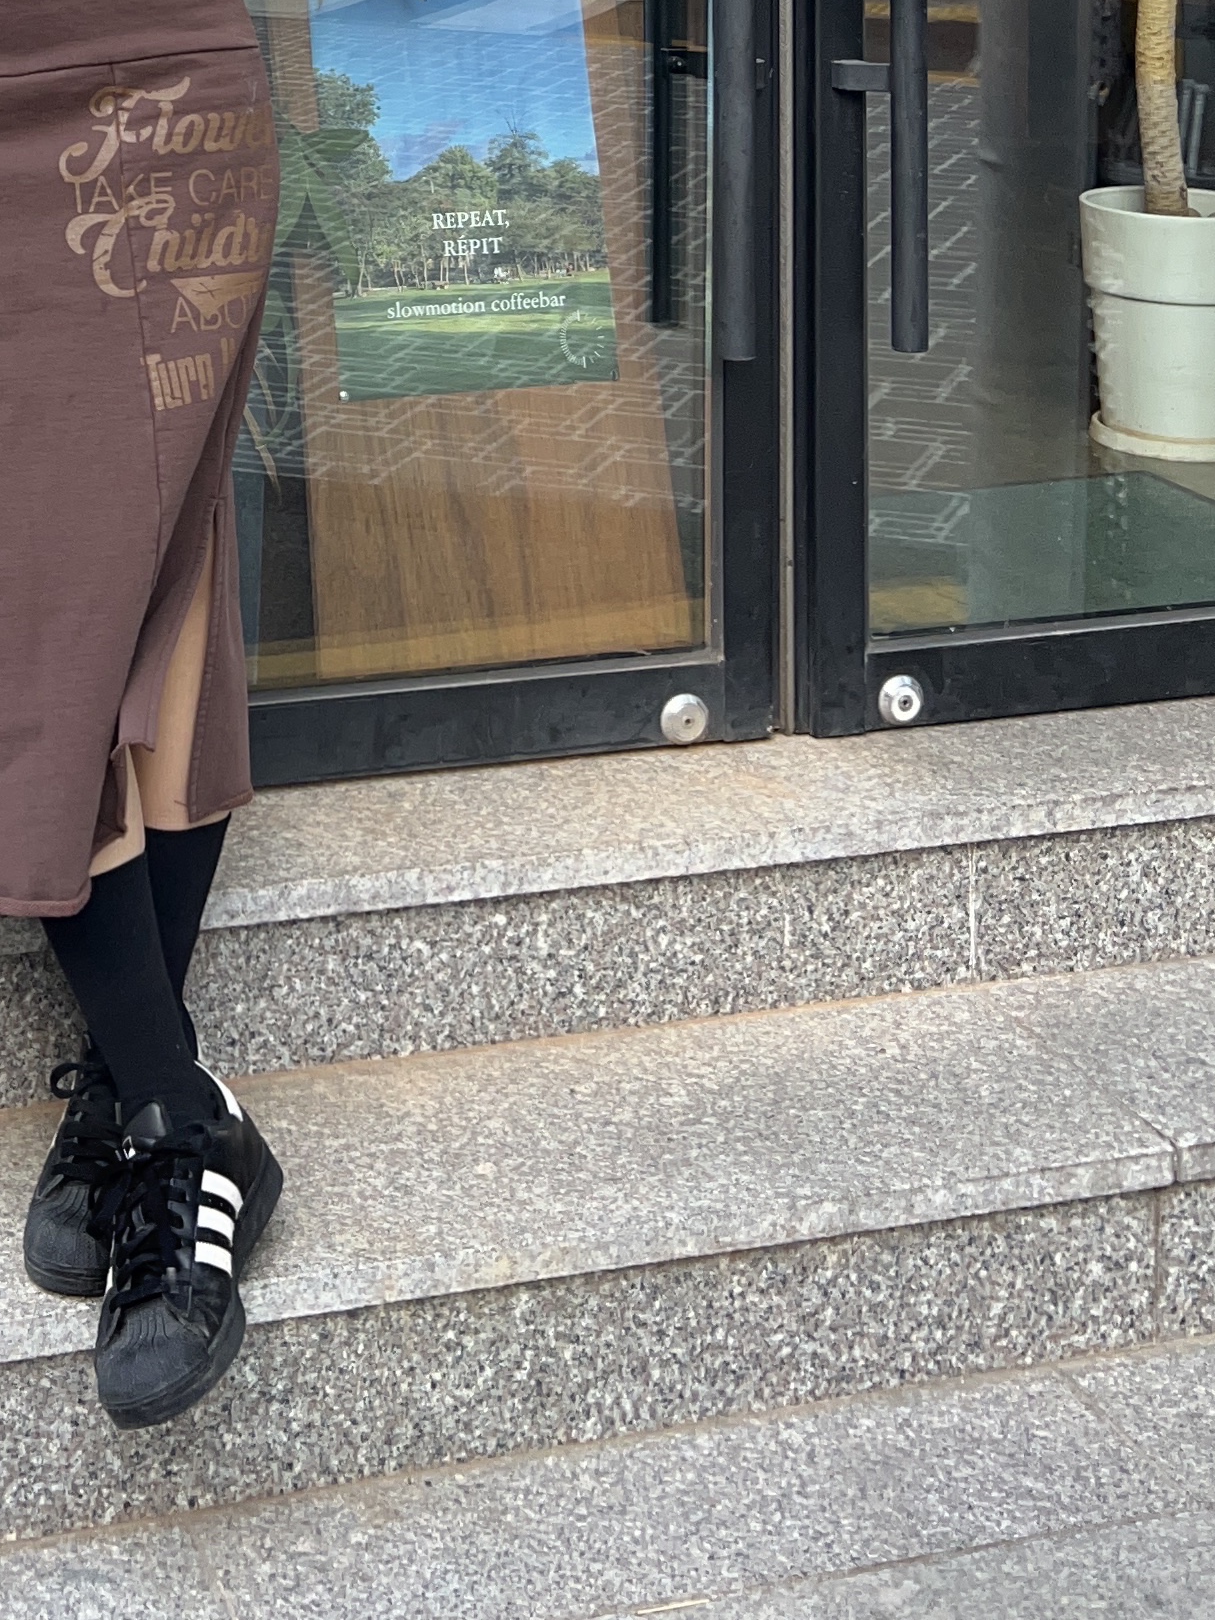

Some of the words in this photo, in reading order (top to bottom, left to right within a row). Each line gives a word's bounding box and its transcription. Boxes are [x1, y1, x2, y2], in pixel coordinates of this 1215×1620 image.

[188, 165, 274, 206] CARE
[432, 209, 511, 230] REPEAT,
[443, 234, 503, 257] RÉPIT
[387, 296, 486, 319] slowmotion
[490, 291, 567, 313] coffeebar
